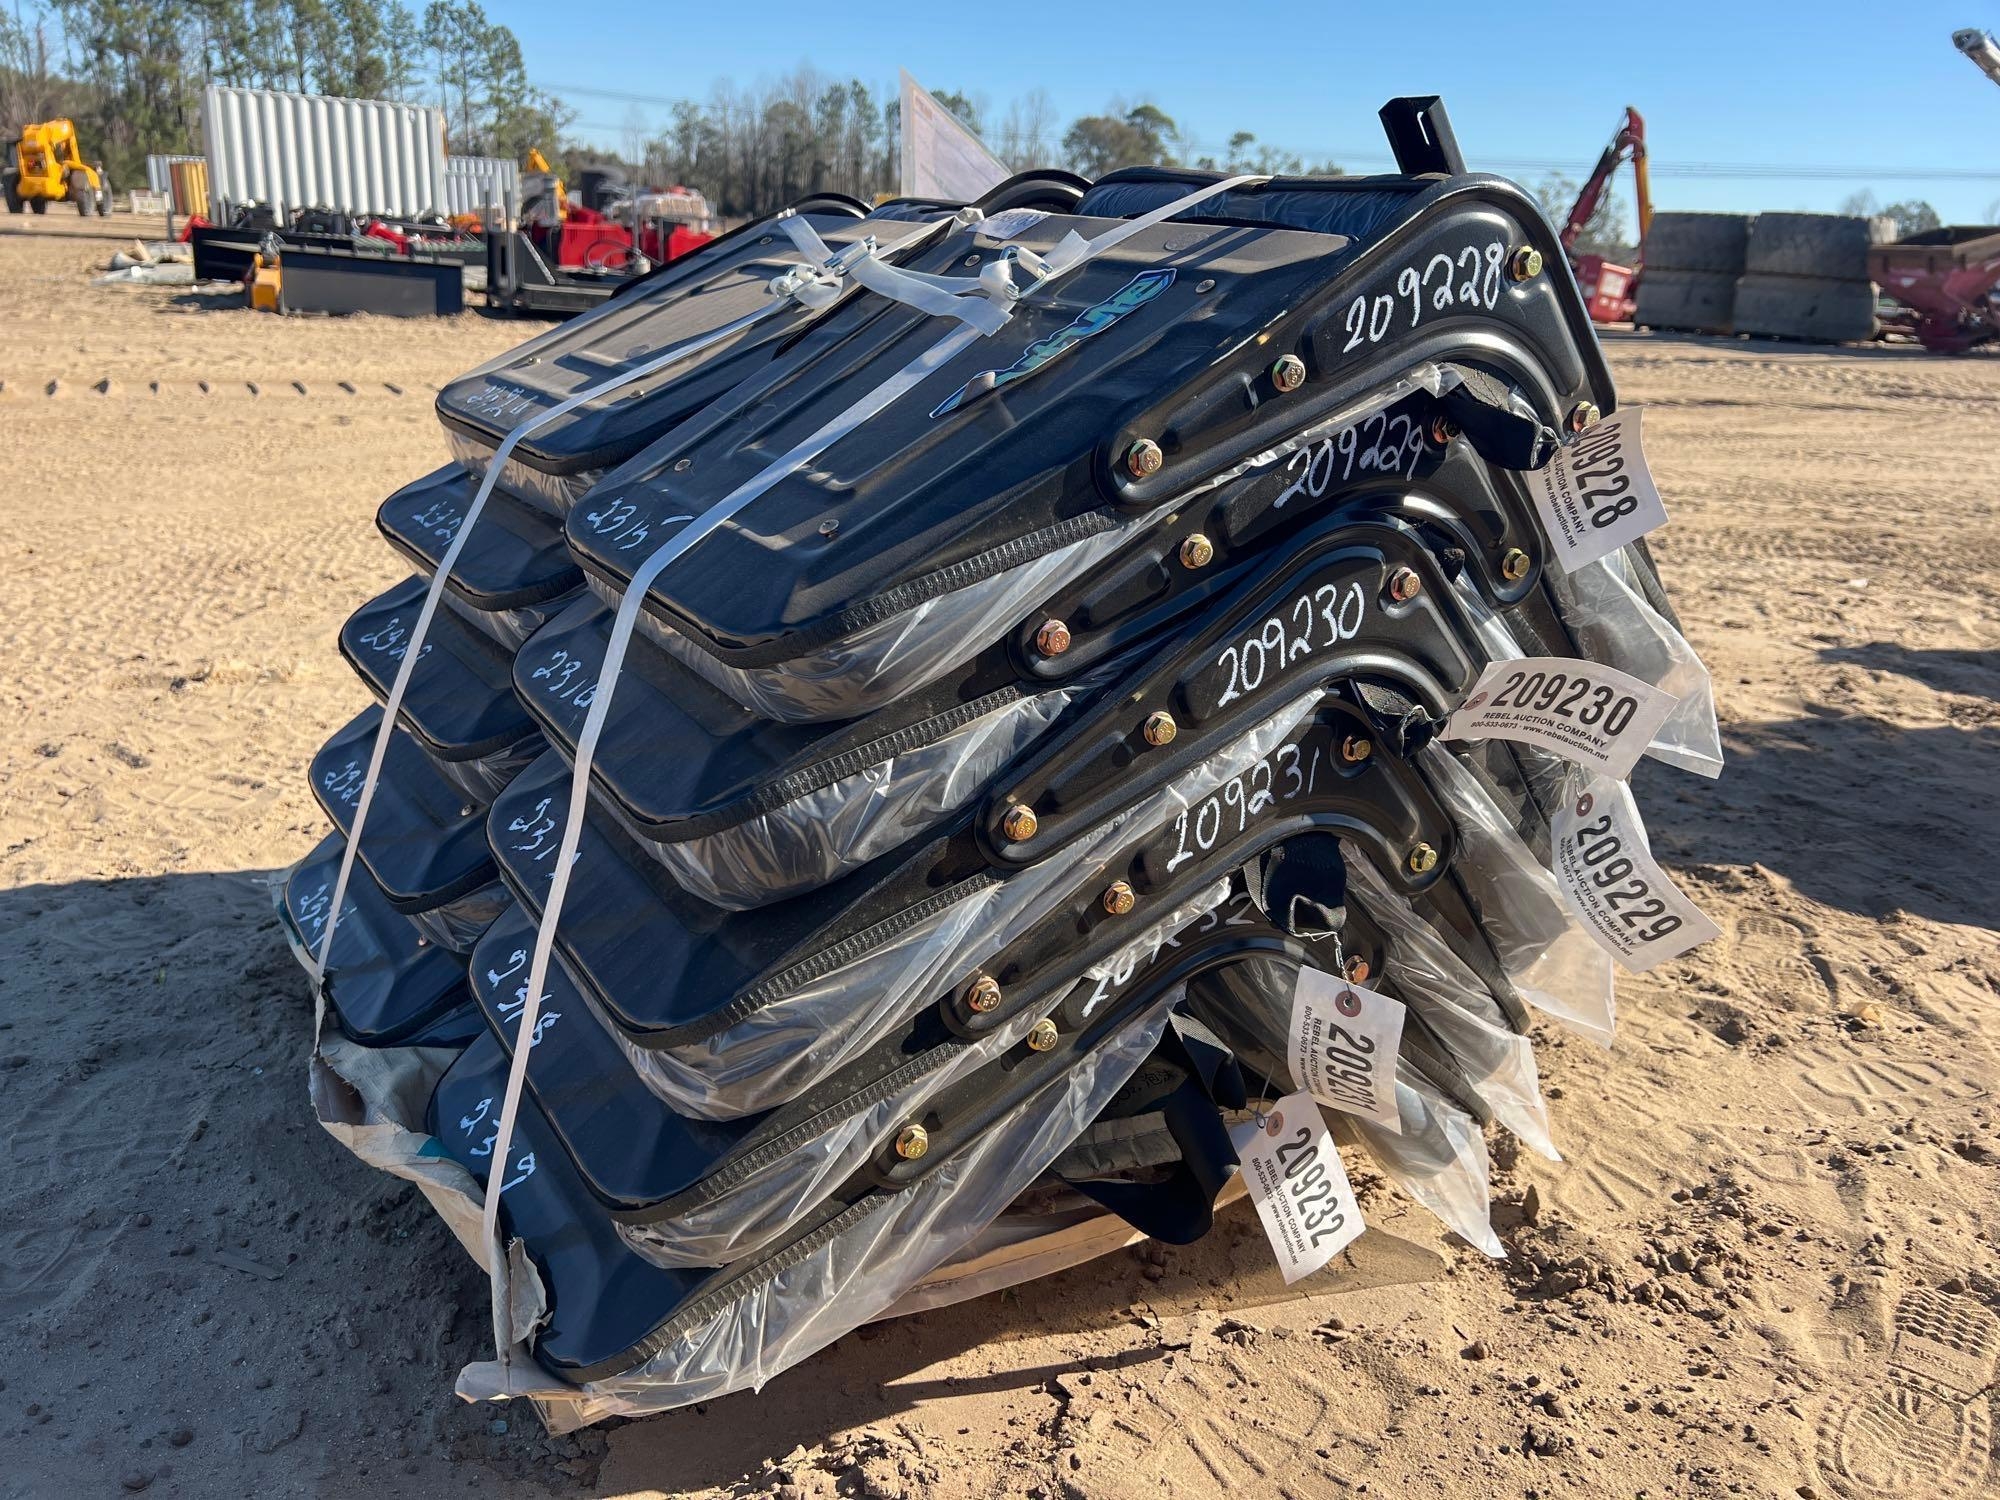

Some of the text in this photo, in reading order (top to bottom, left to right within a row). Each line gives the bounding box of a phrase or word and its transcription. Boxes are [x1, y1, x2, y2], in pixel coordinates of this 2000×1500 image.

[1343, 241, 1505, 354] 209228
[1273, 411, 1424, 509] 209229
[1570, 422, 1638, 529] 209228
[1544, 476, 1578, 549] www.rebelauction.net
[1562, 491, 1587, 534] COMPANY
[1217, 582, 1365, 708] 209230
[1470, 720, 1610, 762] 800-533-0673 www.rebelauction.net
[1483, 712, 1607, 749] REBEL AUCTION COMPANY
[1490, 671, 1638, 737] 209230
[1167, 743, 1320, 873] 209231
[1566, 838, 1637, 946] REBEL AUCTION COMPANY
[1572, 888, 1633, 957] www.rebelauction.net
[1576, 815, 1683, 942] 209229
[1300, 1005, 1313, 1054] 800-533-0673
[1311, 1017, 1322, 1046] REBEL
[1325, 1022, 1380, 1113] 209231
[460, 1097, 536, 1193] 239
[1276, 1127, 1345, 1249] 209232
[1252, 1157, 1299, 1265] 800-533-0673 www.rebelauction.net
[1264, 1158, 1306, 1254] REBEL AUCTION COMPANY
